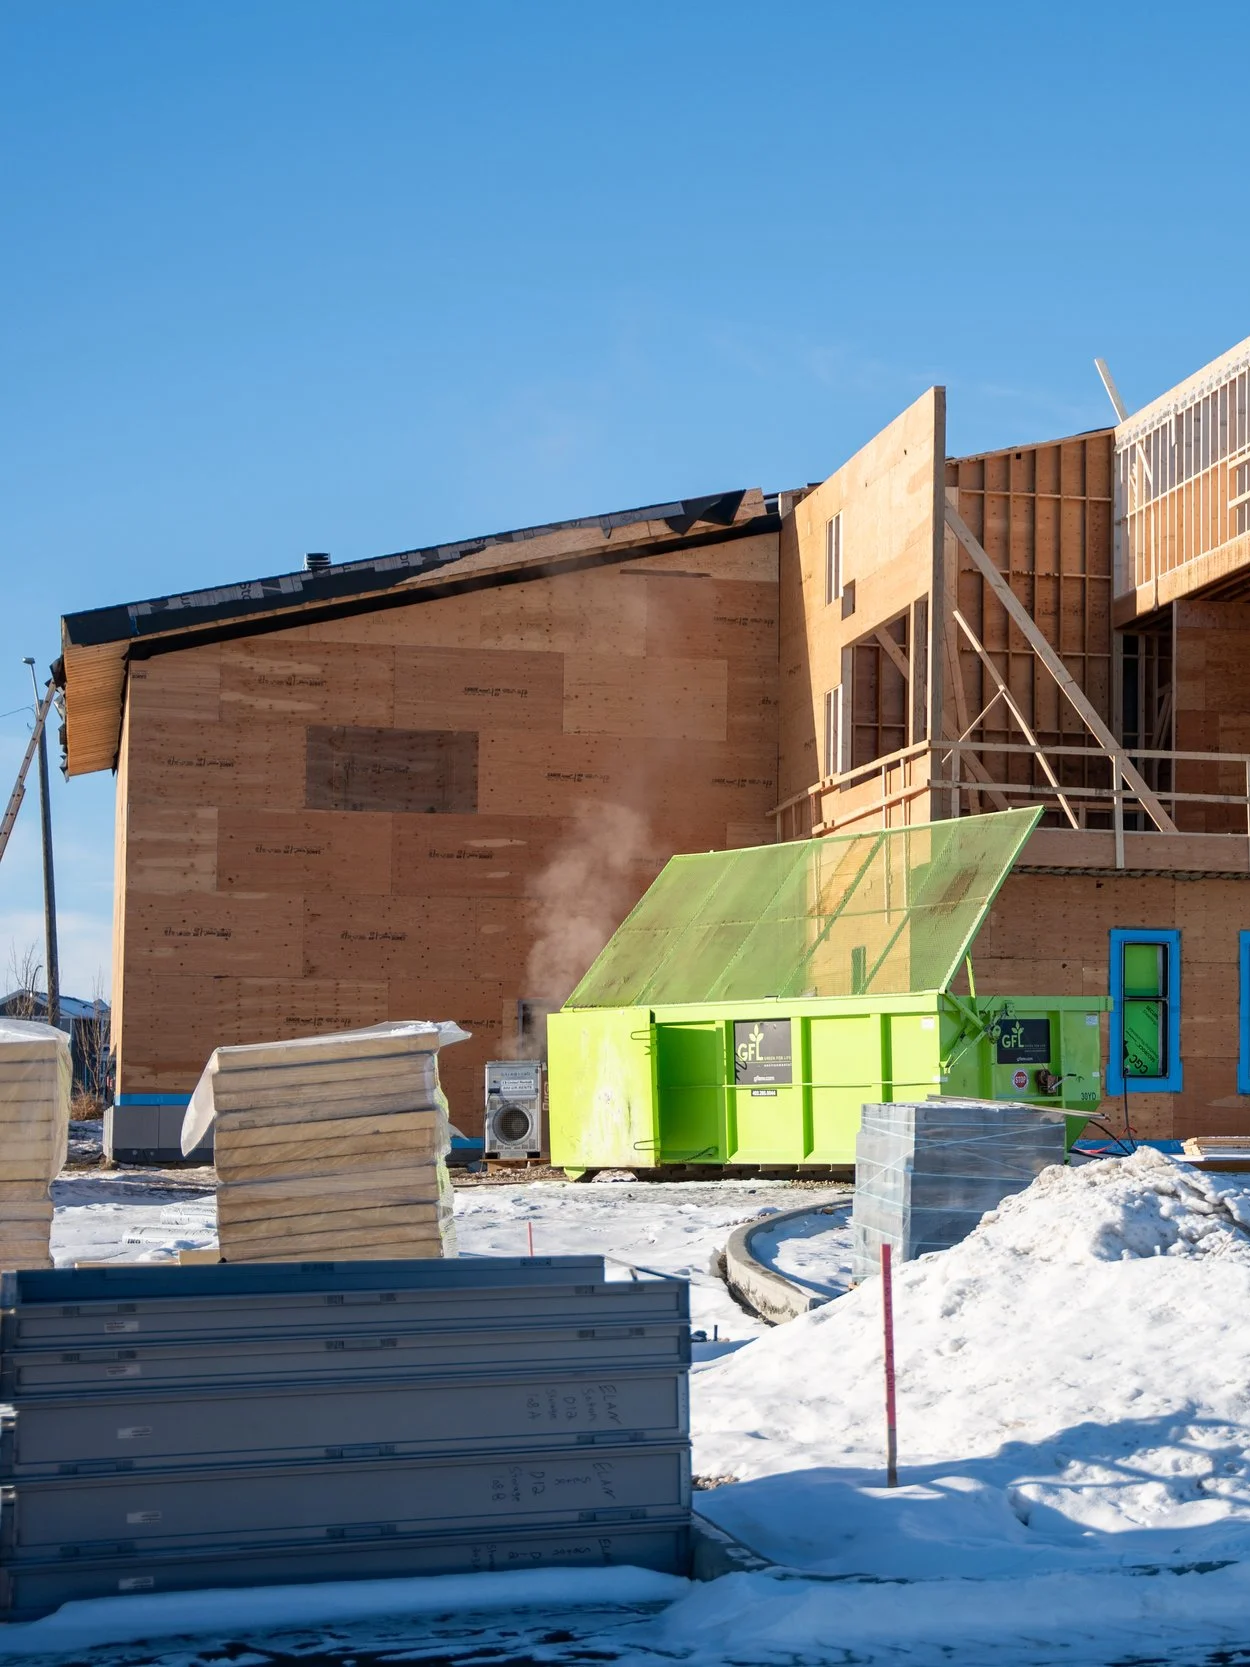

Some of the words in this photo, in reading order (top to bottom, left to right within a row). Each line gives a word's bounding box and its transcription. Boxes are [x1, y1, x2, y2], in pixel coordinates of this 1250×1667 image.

[1002, 1032, 1024, 1048] GFL
[738, 1040, 764, 1061] GFL
[1129, 1054, 1148, 1074] CGC
[1015, 1076, 1026, 1084] STOP
[599, 1384, 622, 1424] ELAN
[593, 1462, 616, 1499] ELAN
